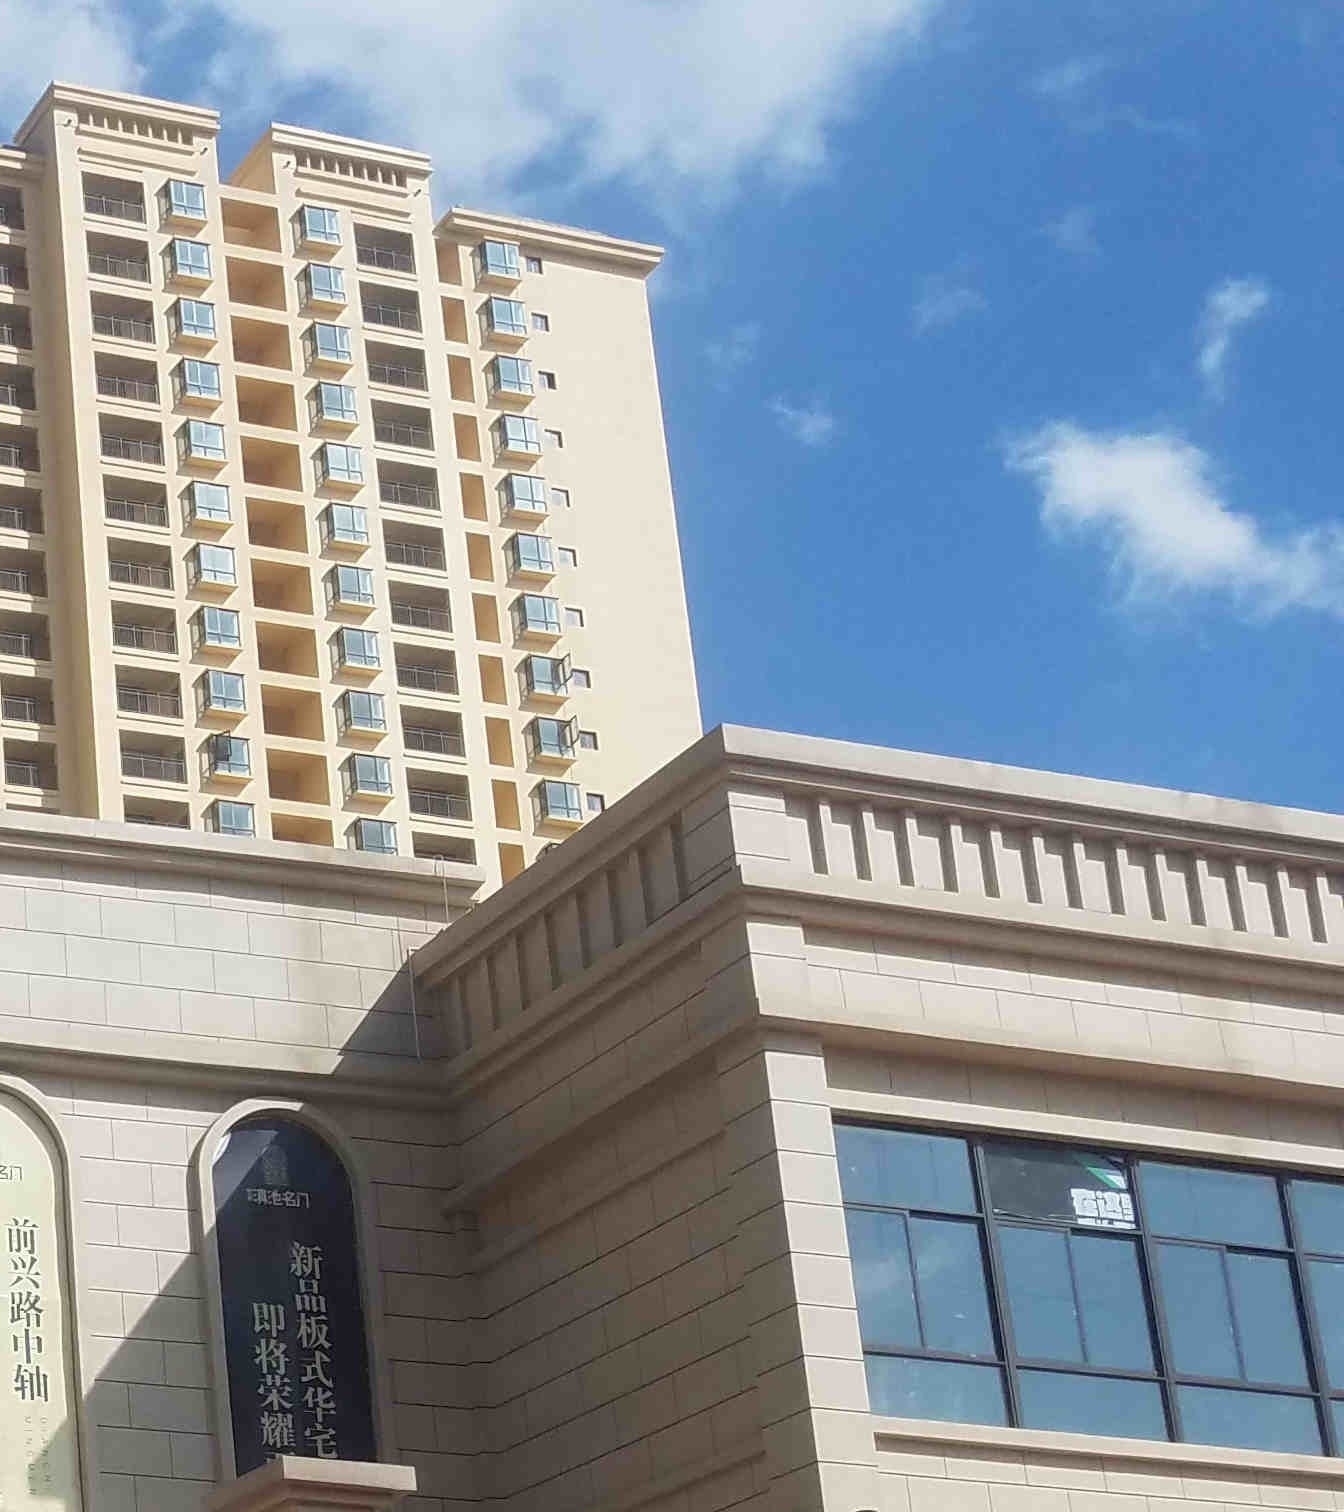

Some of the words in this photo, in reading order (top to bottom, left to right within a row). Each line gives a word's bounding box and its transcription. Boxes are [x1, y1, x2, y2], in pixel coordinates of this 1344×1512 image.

[4, 1216, 50, 1404] 前兴路中轴
[253, 1302, 296, 1463] 即将荣耀
[290, 1240, 338, 1459] 新品板式华宅
